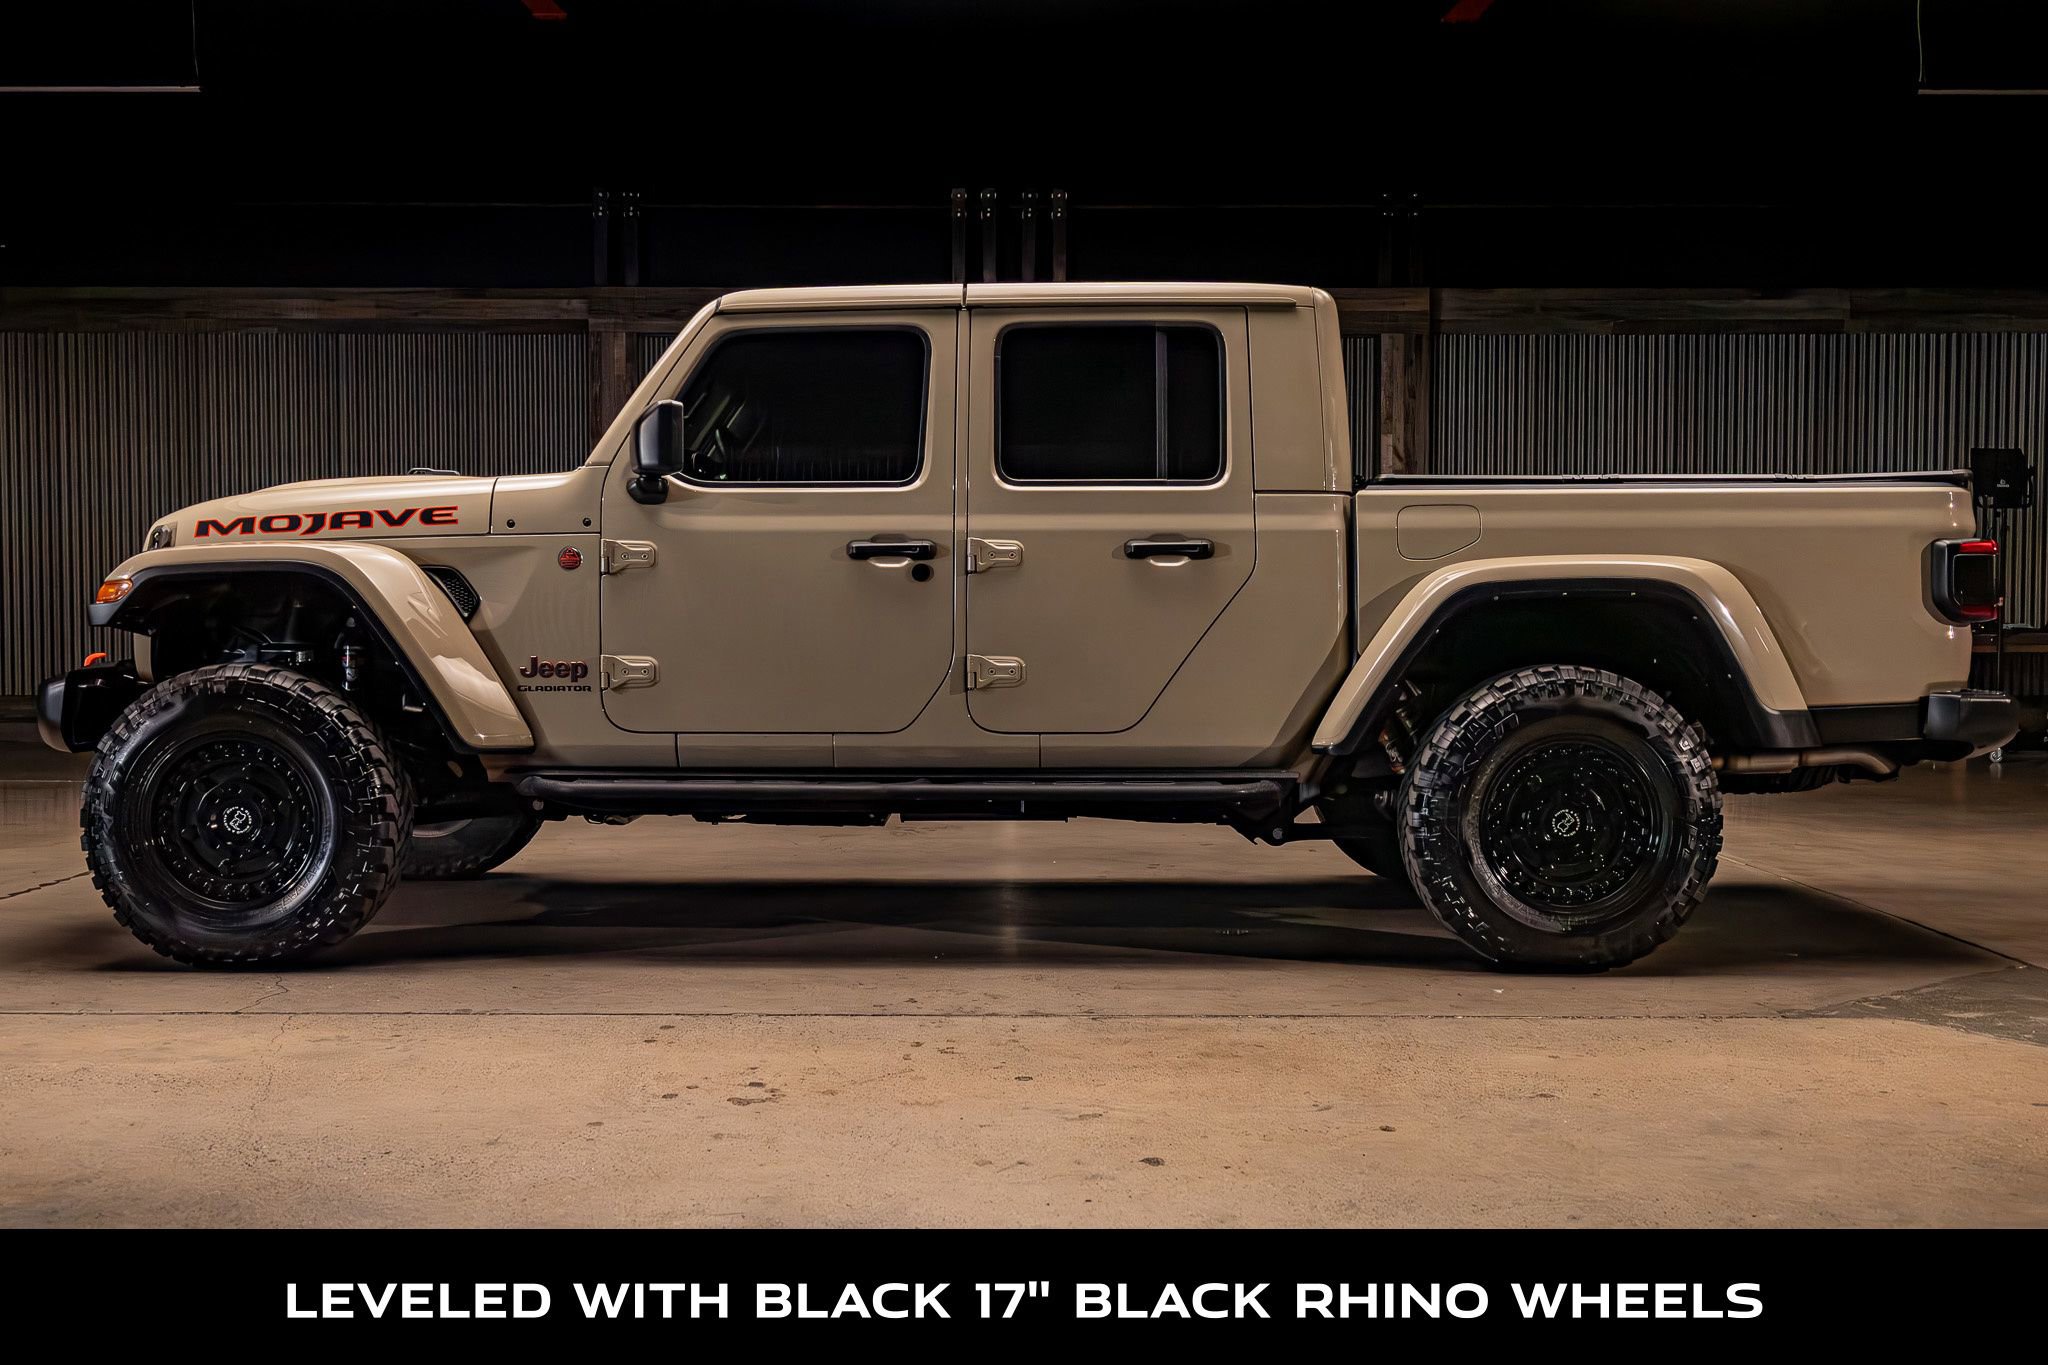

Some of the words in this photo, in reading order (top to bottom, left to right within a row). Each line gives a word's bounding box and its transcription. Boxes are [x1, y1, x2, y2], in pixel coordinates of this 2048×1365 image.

[194, 505, 459, 538] MOJAVE
[519, 655, 588, 683] Jeep
[517, 684, 591, 692] GLADIATOR
